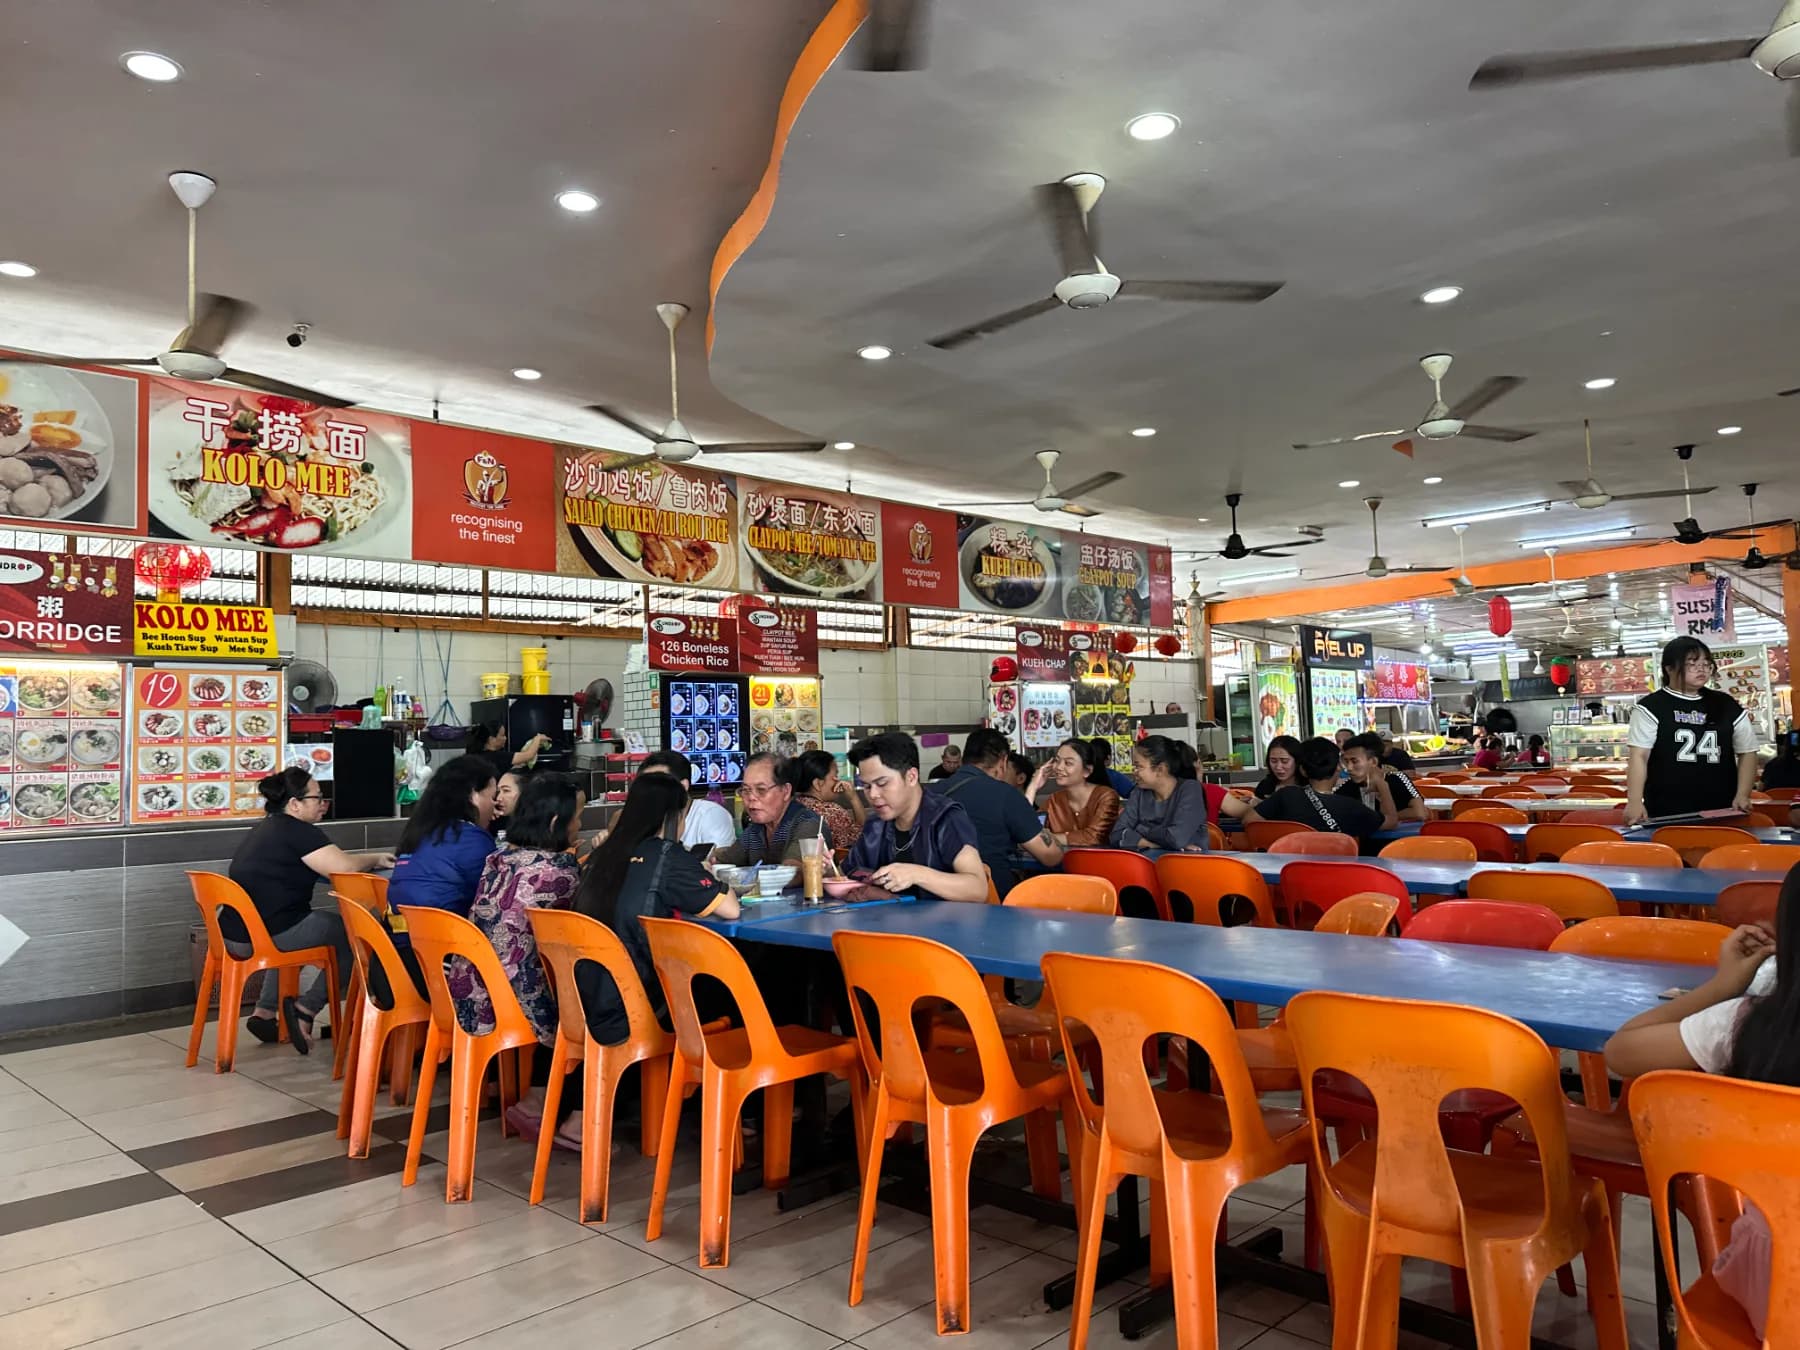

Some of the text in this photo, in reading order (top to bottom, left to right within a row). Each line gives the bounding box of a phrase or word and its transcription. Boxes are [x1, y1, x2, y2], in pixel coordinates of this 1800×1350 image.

[183, 397, 368, 461] 干捞面
[202, 449, 352, 498] KOLO MEE
[451, 513, 523, 533] recognising
[564, 496, 729, 544] SALAD CHICKEN/LU ROU RICE
[459, 528, 516, 544] the finest
[748, 524, 876, 562] CLAYPOT MEE/TOM YAM MEE
[0, 562, 33, 571] DROP
[902, 568, 940, 580] recognising
[981, 555, 1042, 579] KUEH CHAP
[907, 578, 937, 589] the finest
[1079, 565, 1113, 588] CLAYPOT
[1116, 571, 1137, 590] SOUP
[37, 596, 64, 618] 粥
[1676, 597, 1728, 616] SUSI
[135, 604, 268, 632] KOLO MEE
[0, 620, 122, 642] ORRIDGE
[142, 633, 268, 645] Bee Hoon Sup Wantan Sup
[147, 642, 172, 650] Kueh
[174, 643, 198, 651] Tiaw
[200, 644, 218, 653] Sup
[248, 646, 265, 654] Sup
[660, 641, 730, 654] 126 Boneless
[1347, 642, 1365, 658] UP
[661, 653, 729, 666] Chicken Rice
[1022, 657, 1066, 669] KUEH CHAP
[146, 673, 178, 707] 19
[1397, 683, 1417, 699] Food
[1674, 729, 1721, 763] 24
